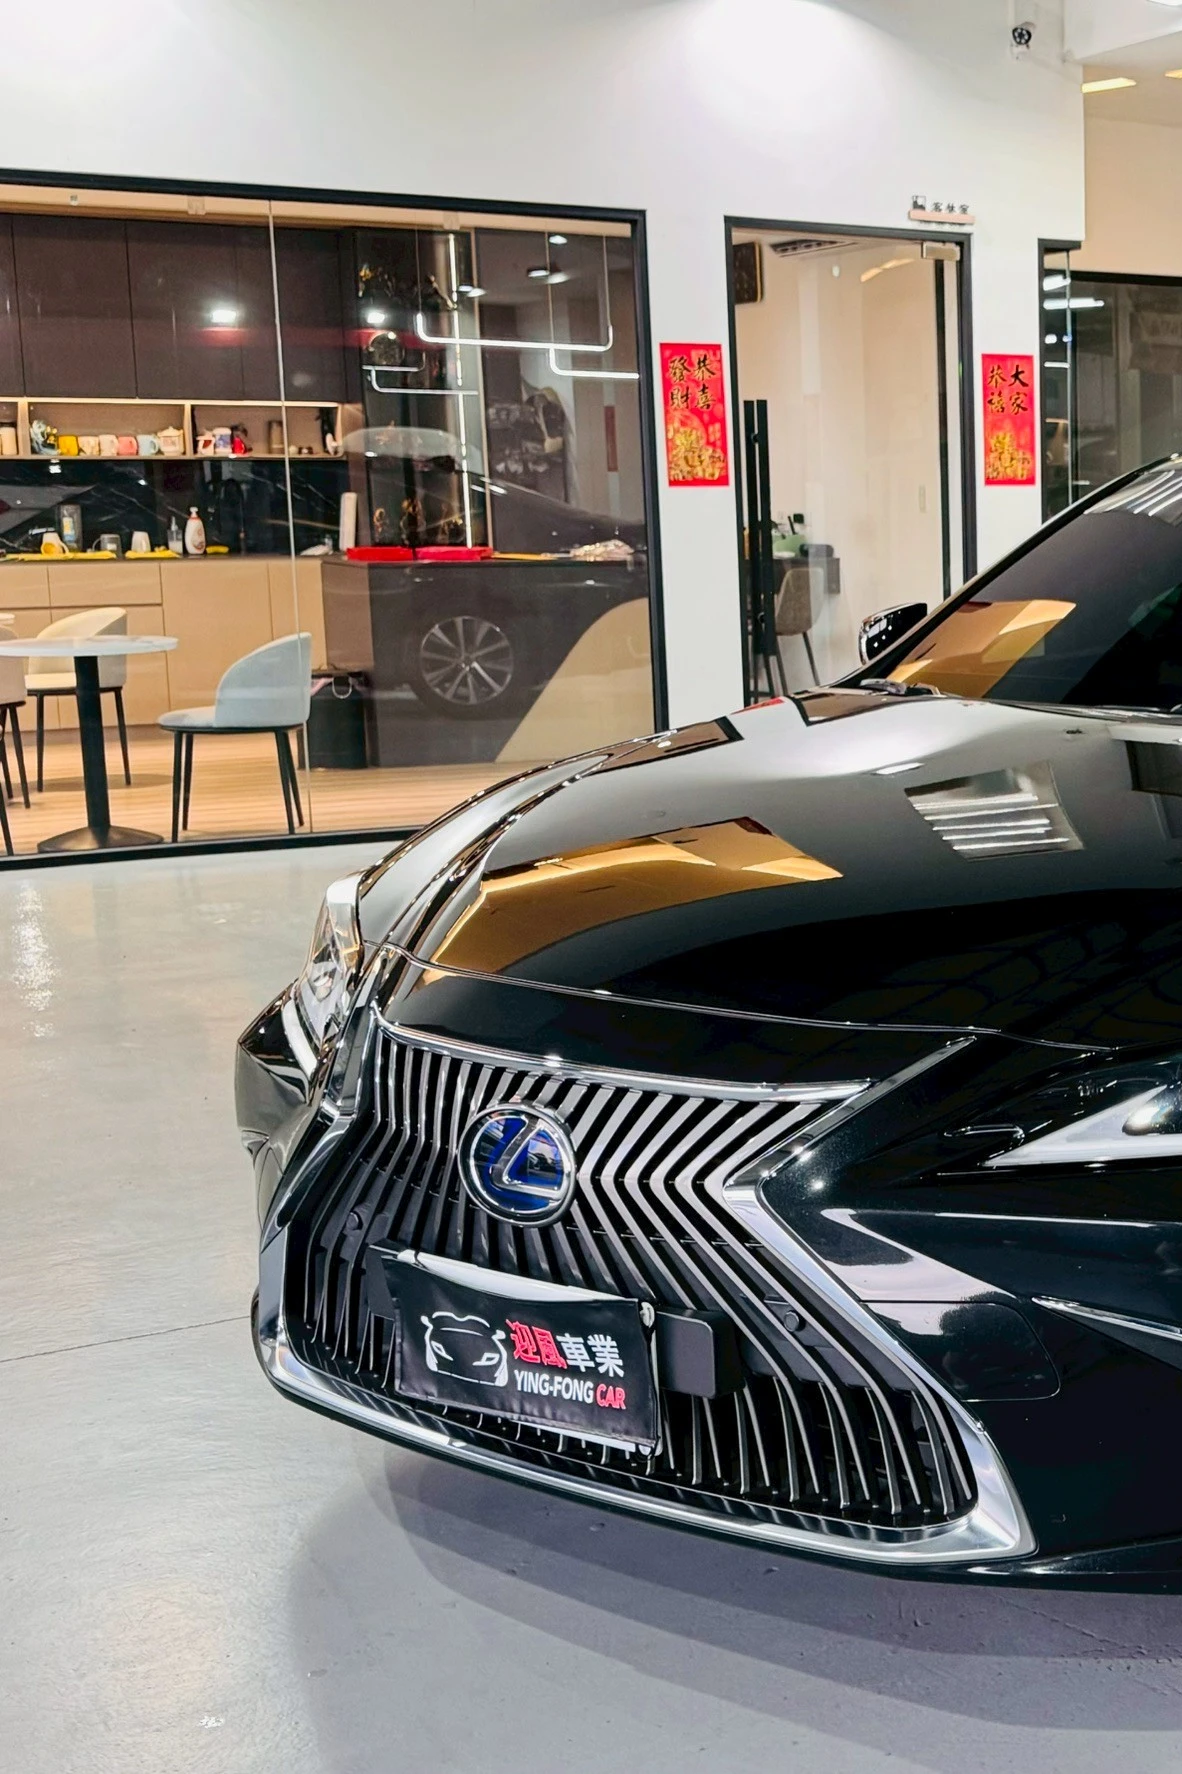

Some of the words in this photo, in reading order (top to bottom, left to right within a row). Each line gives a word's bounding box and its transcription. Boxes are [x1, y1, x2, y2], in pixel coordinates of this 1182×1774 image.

[505, 1319, 625, 1377] 迎風車業
[514, 1369, 594, 1404] YING-FONG
[596, 1383, 626, 1410] CAR
